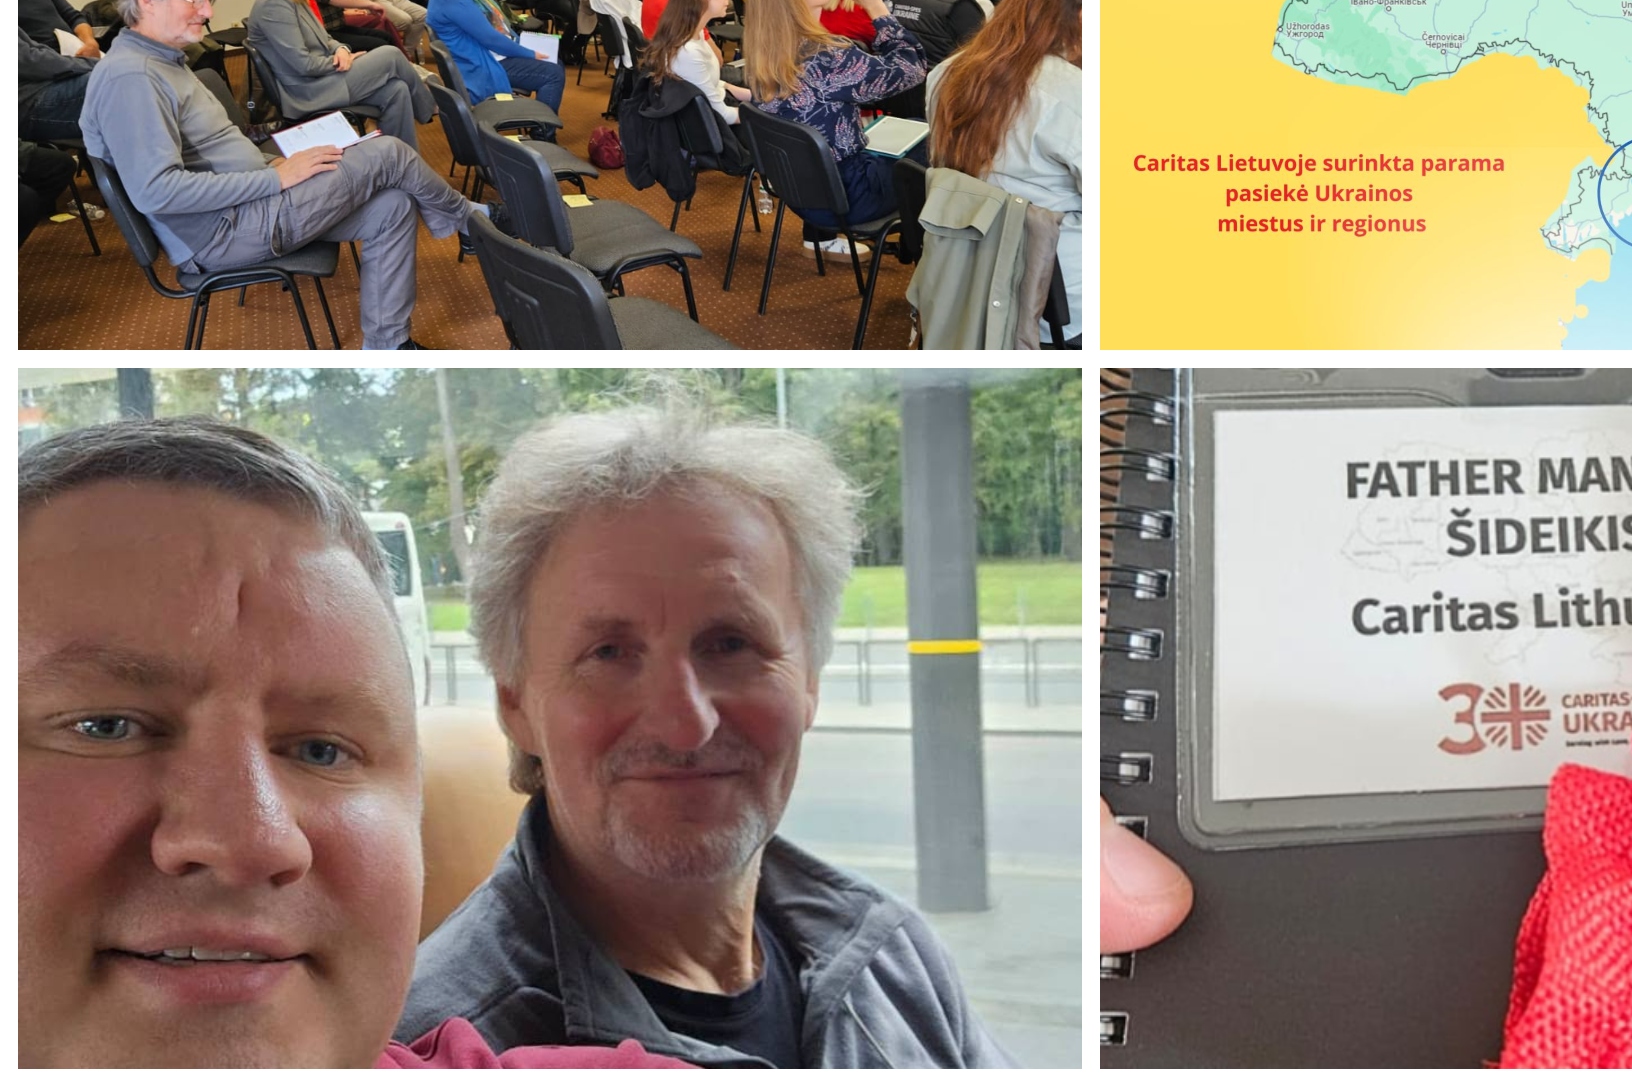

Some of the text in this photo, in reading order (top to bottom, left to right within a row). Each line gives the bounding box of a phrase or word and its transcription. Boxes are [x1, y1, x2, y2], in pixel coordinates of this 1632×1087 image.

[1286, 22, 1330, 31] Užhorodas
[1286, 30, 1325, 40] Ужгород
[1422, 31, 1465, 41] Černovicai
[1425, 41, 1462, 50] Чернівці
[1347, 458, 1524, 499] FATHER
[1352, 590, 1519, 636] Caritas
